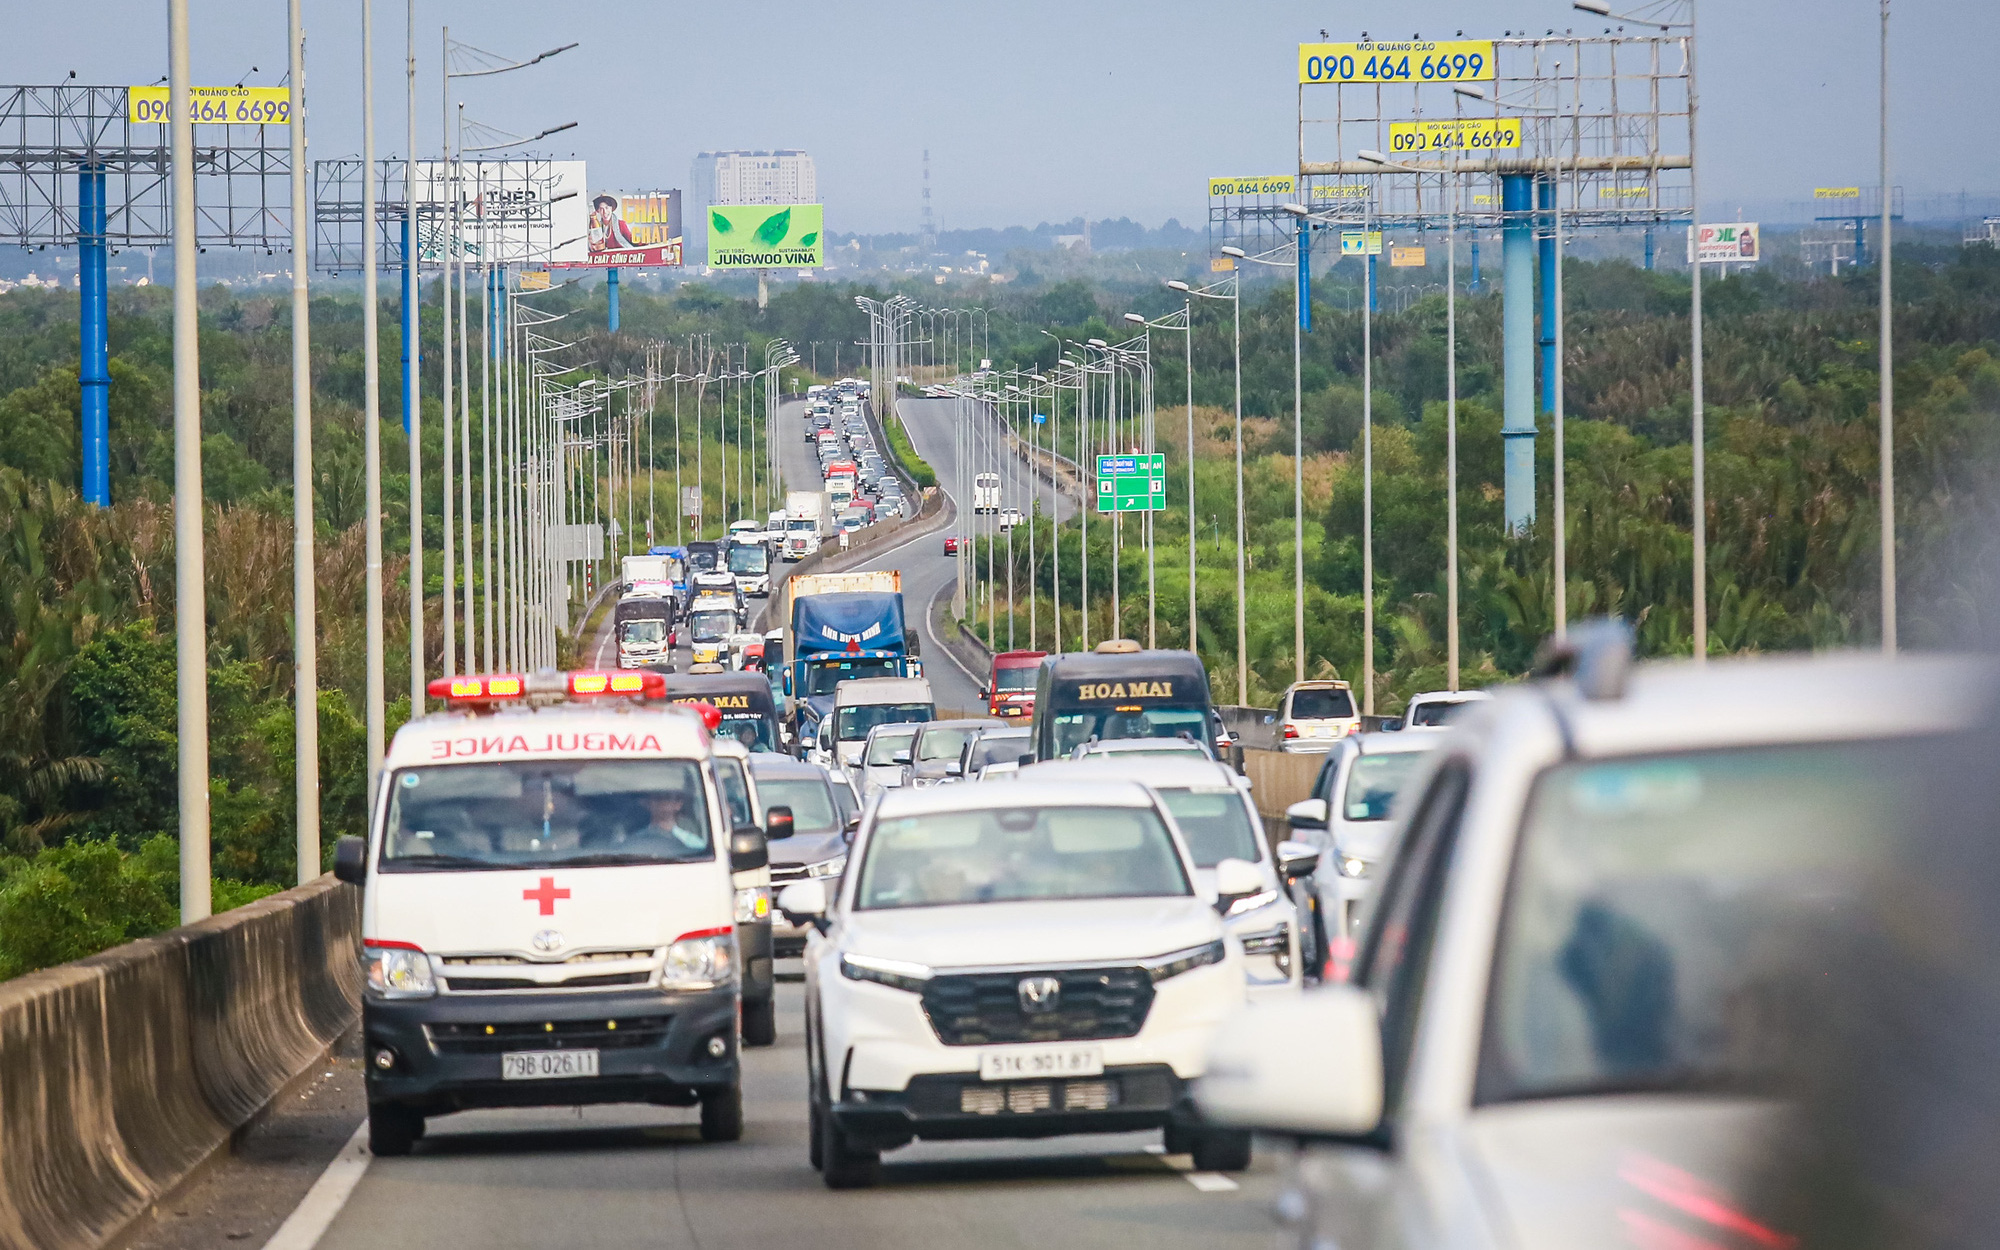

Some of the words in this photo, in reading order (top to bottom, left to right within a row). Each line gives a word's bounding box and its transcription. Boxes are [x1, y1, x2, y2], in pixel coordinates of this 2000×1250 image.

[1308, 55, 1355, 80] 090
[1363, 55, 1411, 80] 464
[1420, 53, 1484, 79] 6699
[235, 100, 290, 122] 6699
[1393, 132, 1426, 150] 090
[1432, 132, 1465, 149] 464
[1471, 129, 1515, 147] 6699
[1212, 184, 1234, 196] 090
[1237, 183, 1259, 195] 464
[1262, 181, 1291, 194] 6699
[714, 254, 782, 266] JUNGWOO
[785, 253, 816, 264] VINA
[1078, 682, 1127, 701] HOA
[1128, 681, 1173, 698] MAI
[713, 695, 749, 709] MAI
